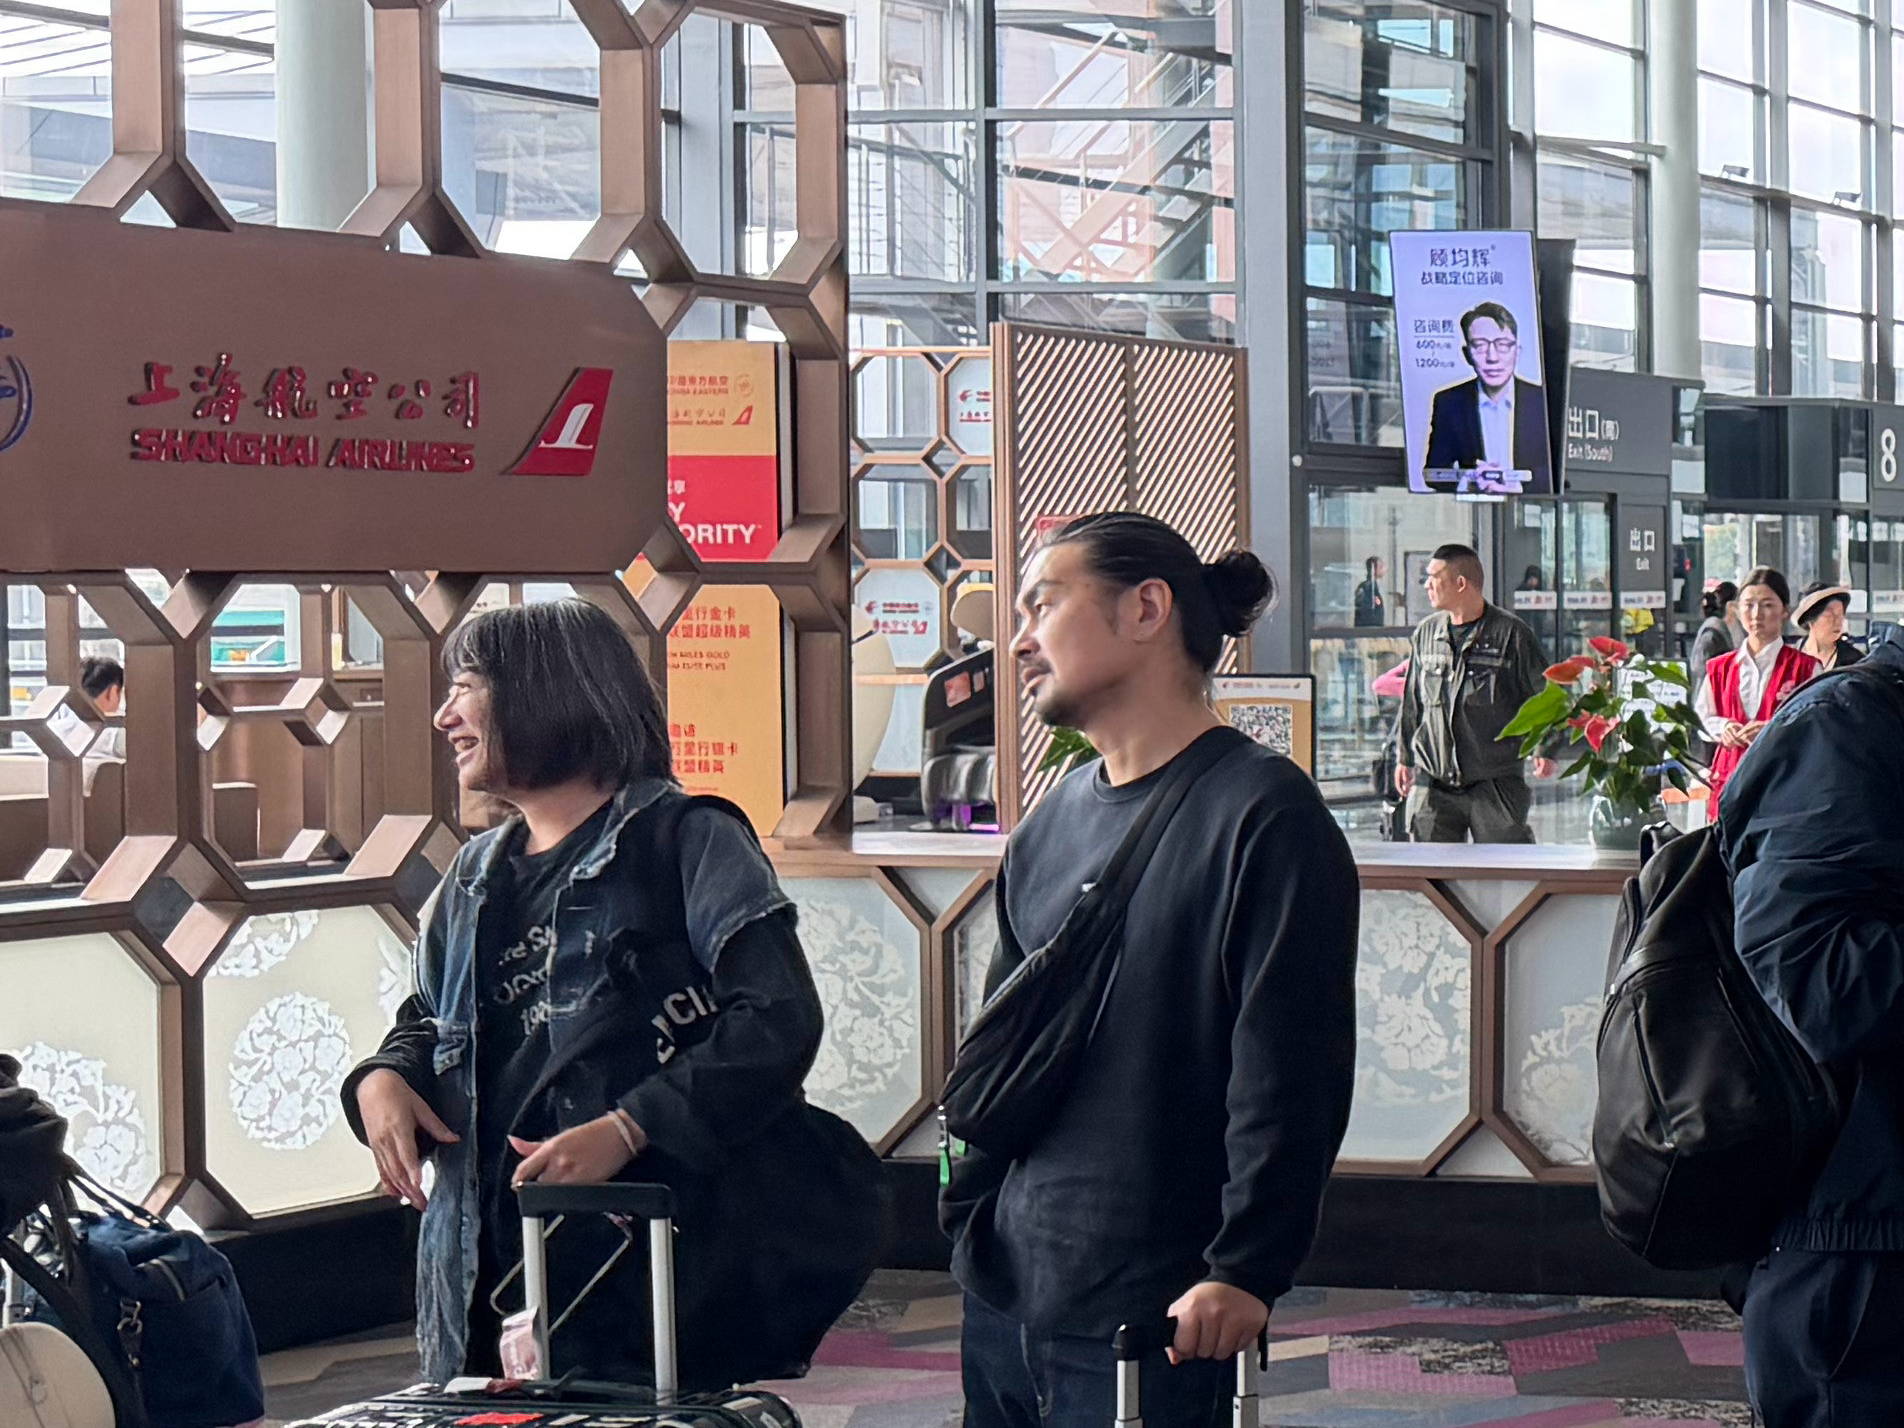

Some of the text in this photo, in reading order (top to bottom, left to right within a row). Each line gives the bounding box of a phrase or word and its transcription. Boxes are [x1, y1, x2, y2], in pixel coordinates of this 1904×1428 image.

[1421, 272, 1504, 286] 战略定位咨询
[127, 352, 480, 429] 上海航空公司
[132, 427, 476, 472] SHANGHAI AIRLINES
[1881, 428, 1897, 482] 8
[679, 523, 756, 545] ORITY
[1630, 527, 1655, 552] 出口
